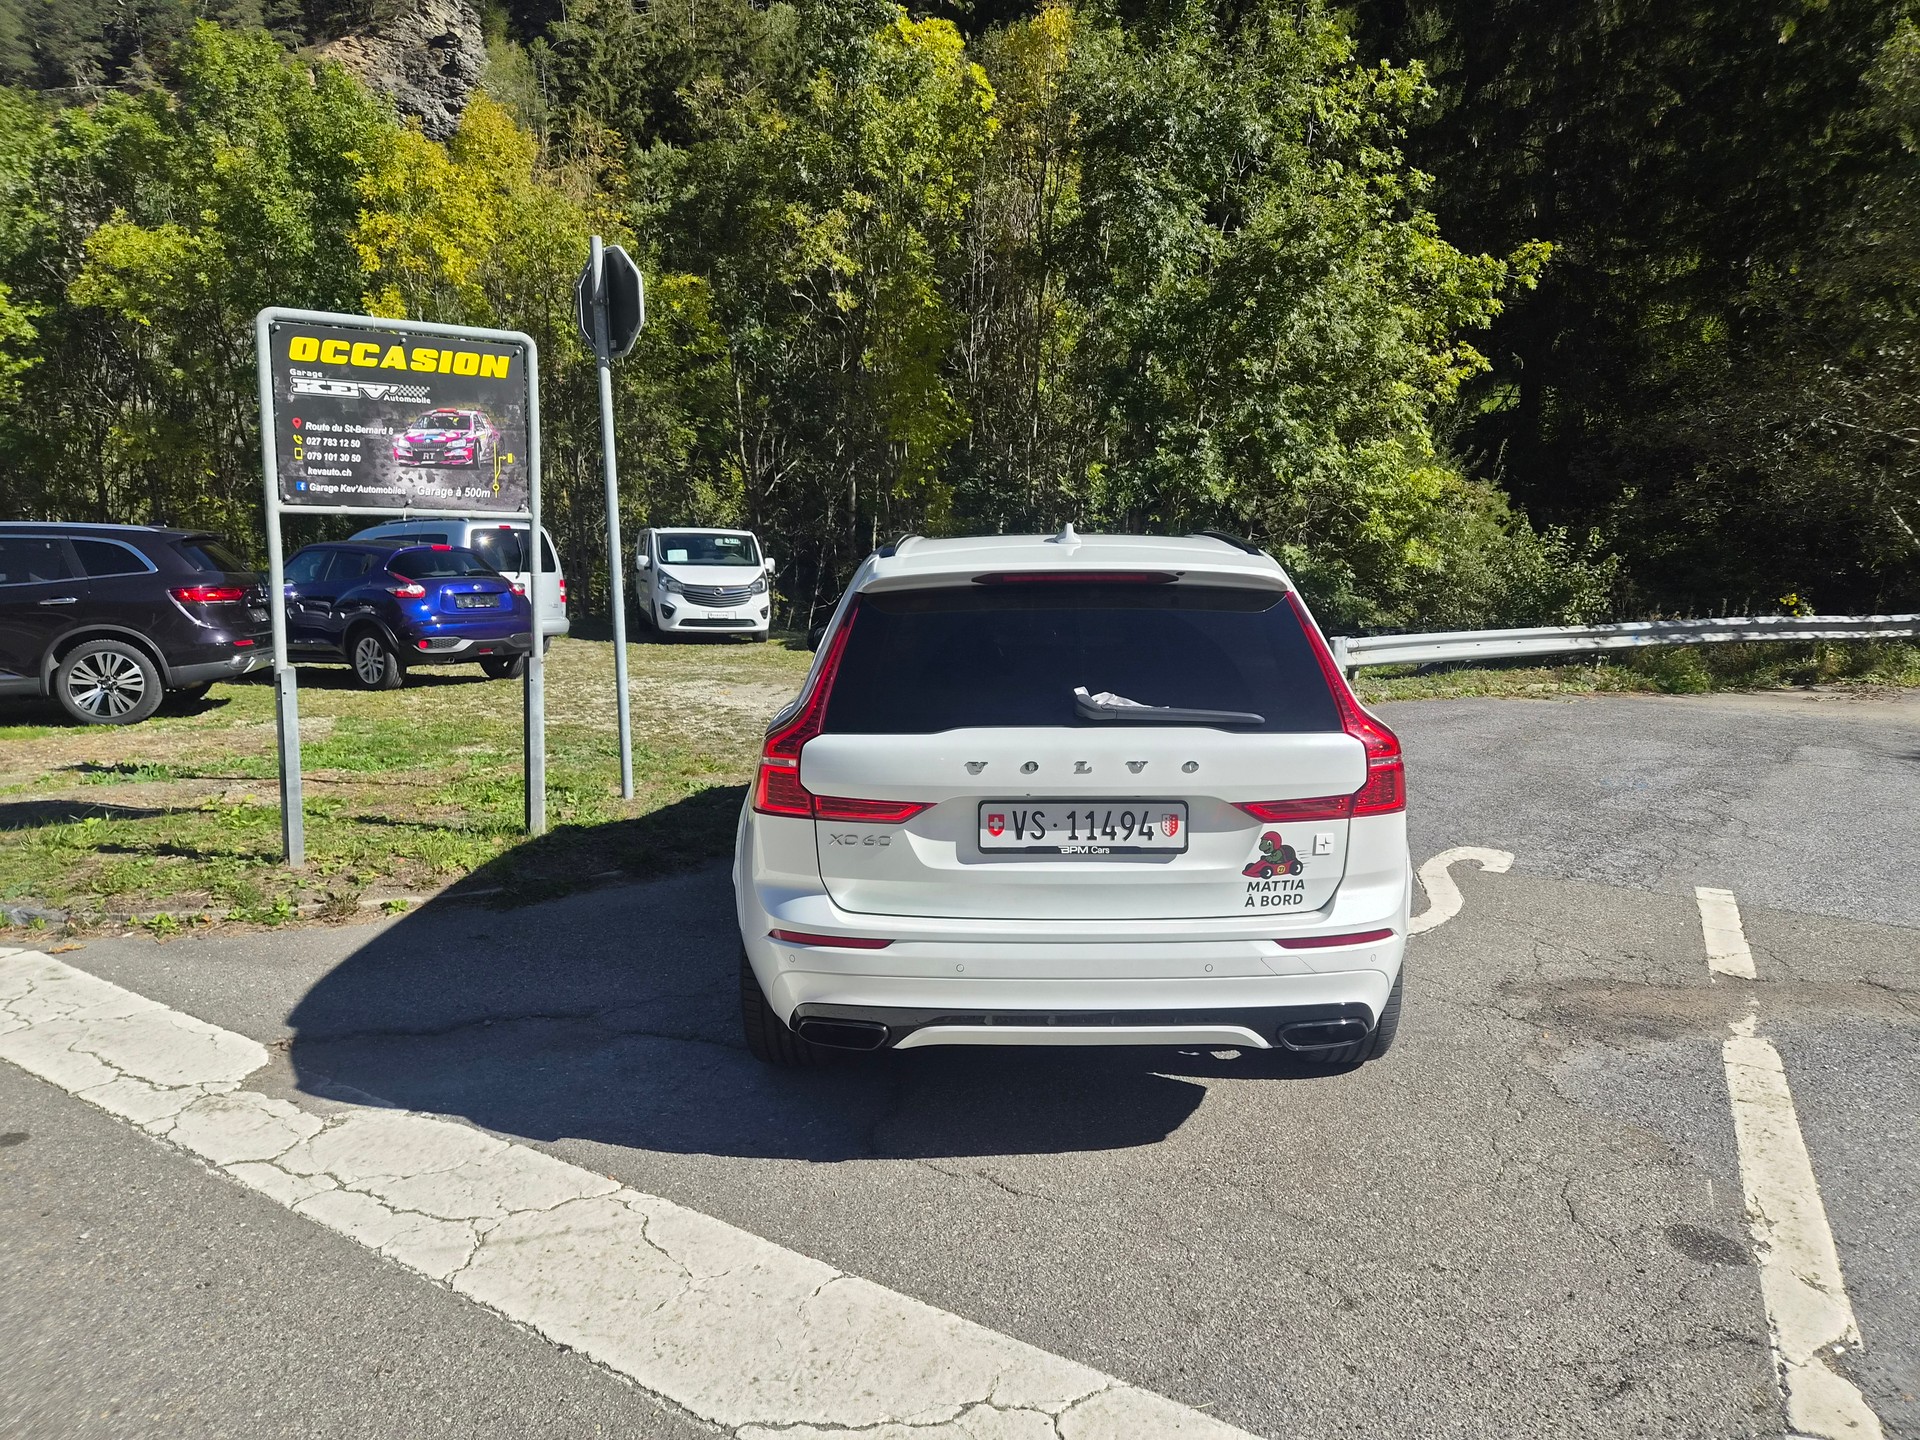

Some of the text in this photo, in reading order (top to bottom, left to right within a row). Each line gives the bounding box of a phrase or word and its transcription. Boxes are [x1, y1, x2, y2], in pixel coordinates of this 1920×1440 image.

[289, 337, 510, 379] OCCASION
[289, 368, 323, 378] Garage
[384, 394, 431, 404] Automobile
[305, 421, 394, 435] Route du St-Bernard 8
[306, 437, 361, 448] 027 783 12 50
[307, 451, 361, 463] 079 101 30 50
[307, 466, 352, 477] kevauto.ch
[309, 483, 339, 494] Garage
[340, 484, 406, 495] Kev'Automobiles
[417, 485, 491, 498] Garage à 500m
[964, 760, 1200, 776] VOLVO
[1058, 845, 1110, 854] BPM Cars
[1246, 879, 1305, 893] MATTIA
[1260, 893, 1303, 907] BORD
